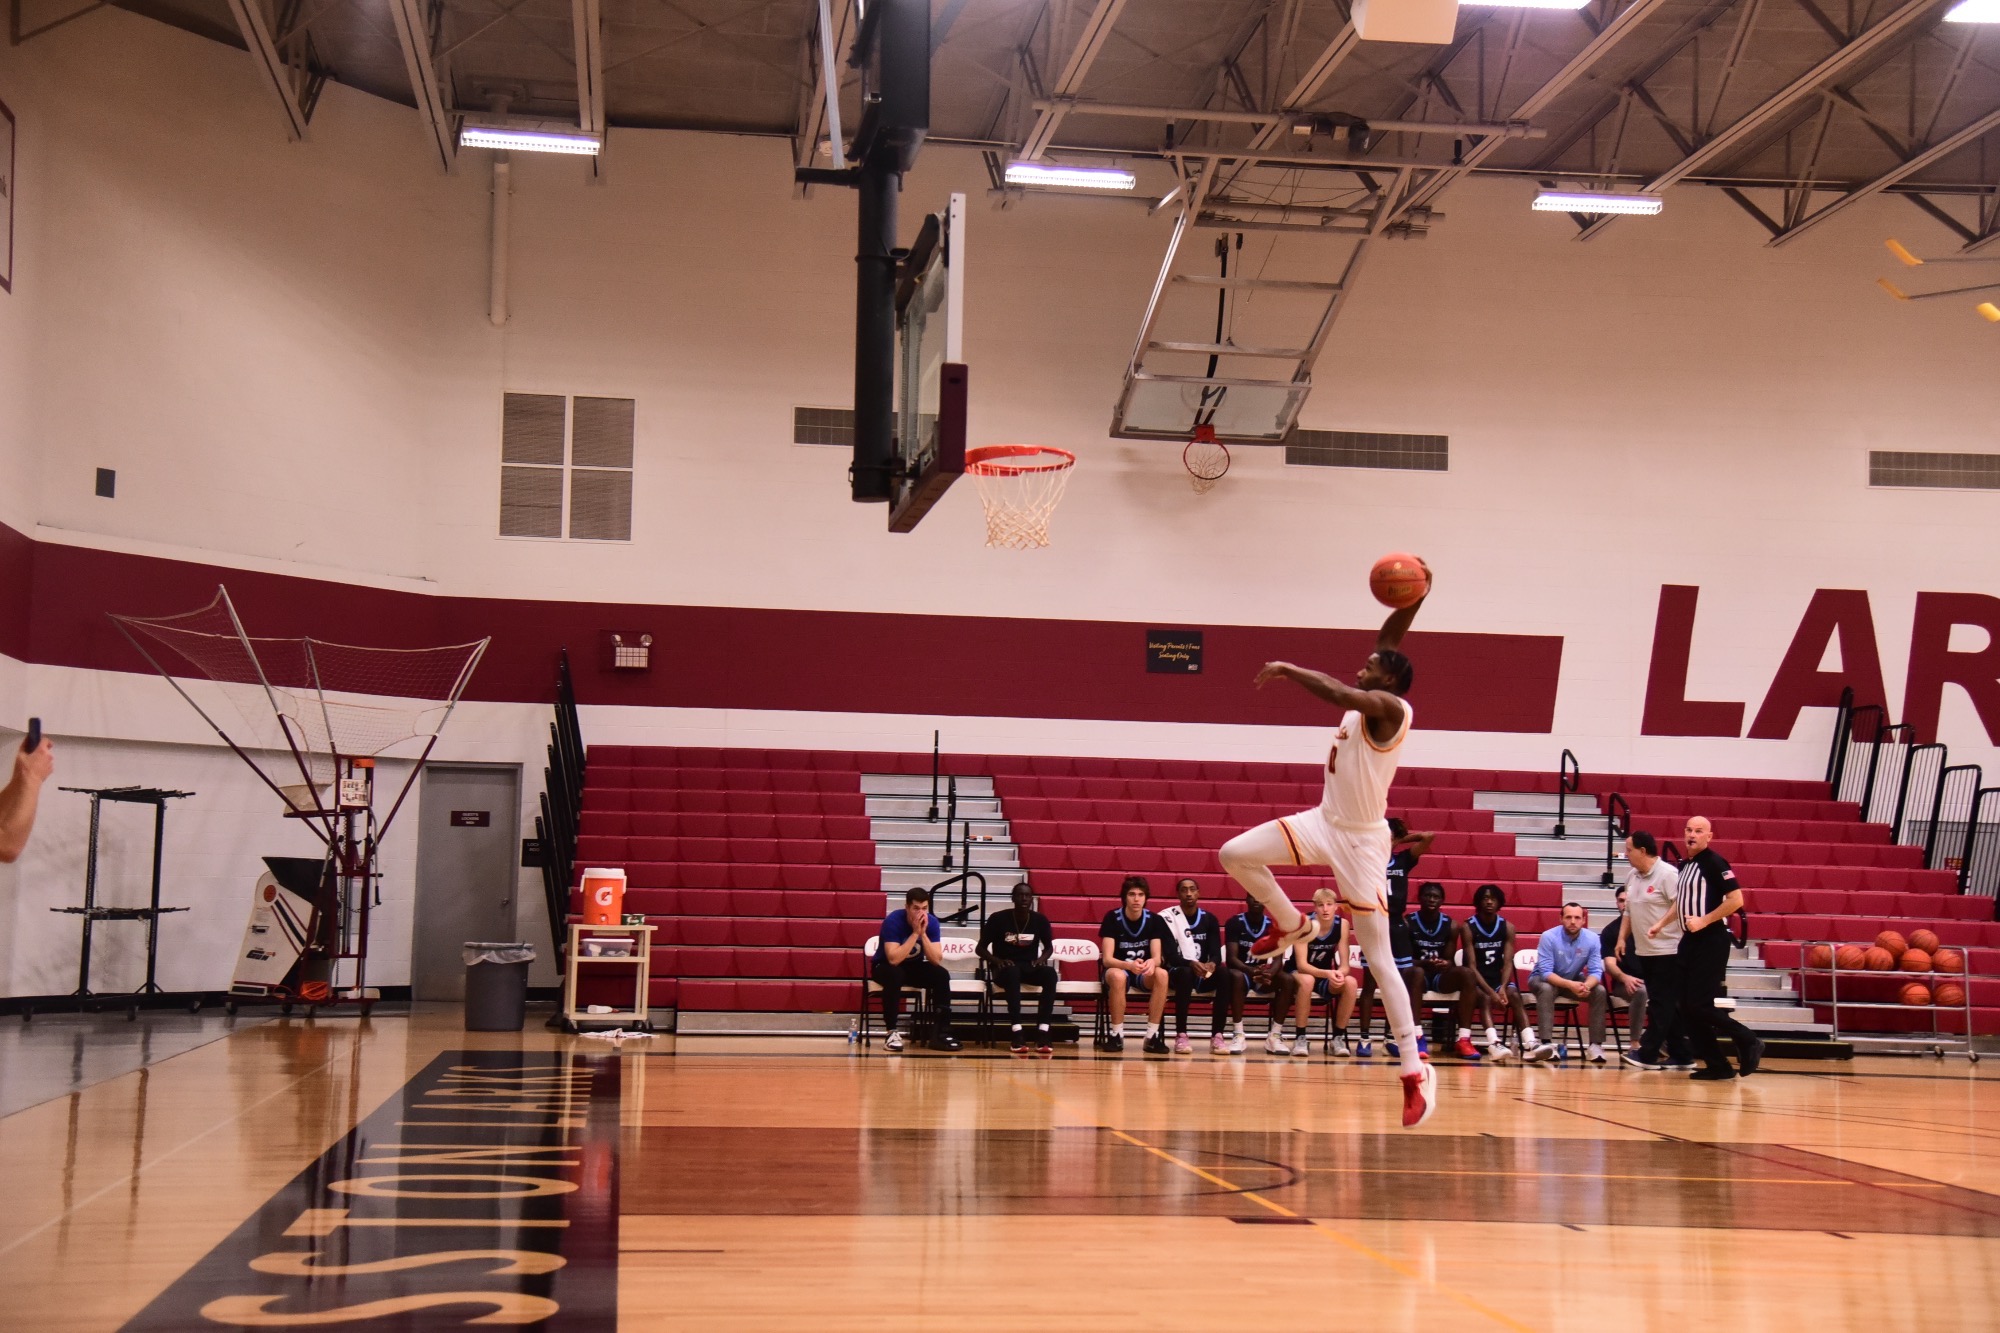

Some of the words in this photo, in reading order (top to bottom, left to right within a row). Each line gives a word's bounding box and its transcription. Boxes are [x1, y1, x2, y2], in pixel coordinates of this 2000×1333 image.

[1387, 869, 1404, 877] CATS
[595, 886, 613, 906] G
[942, 943, 975, 954] ARKS
[1053, 945, 1092, 955] LARKS
[1484, 950, 1496, 965] 5
[394, 1065, 597, 1128] LARKS
